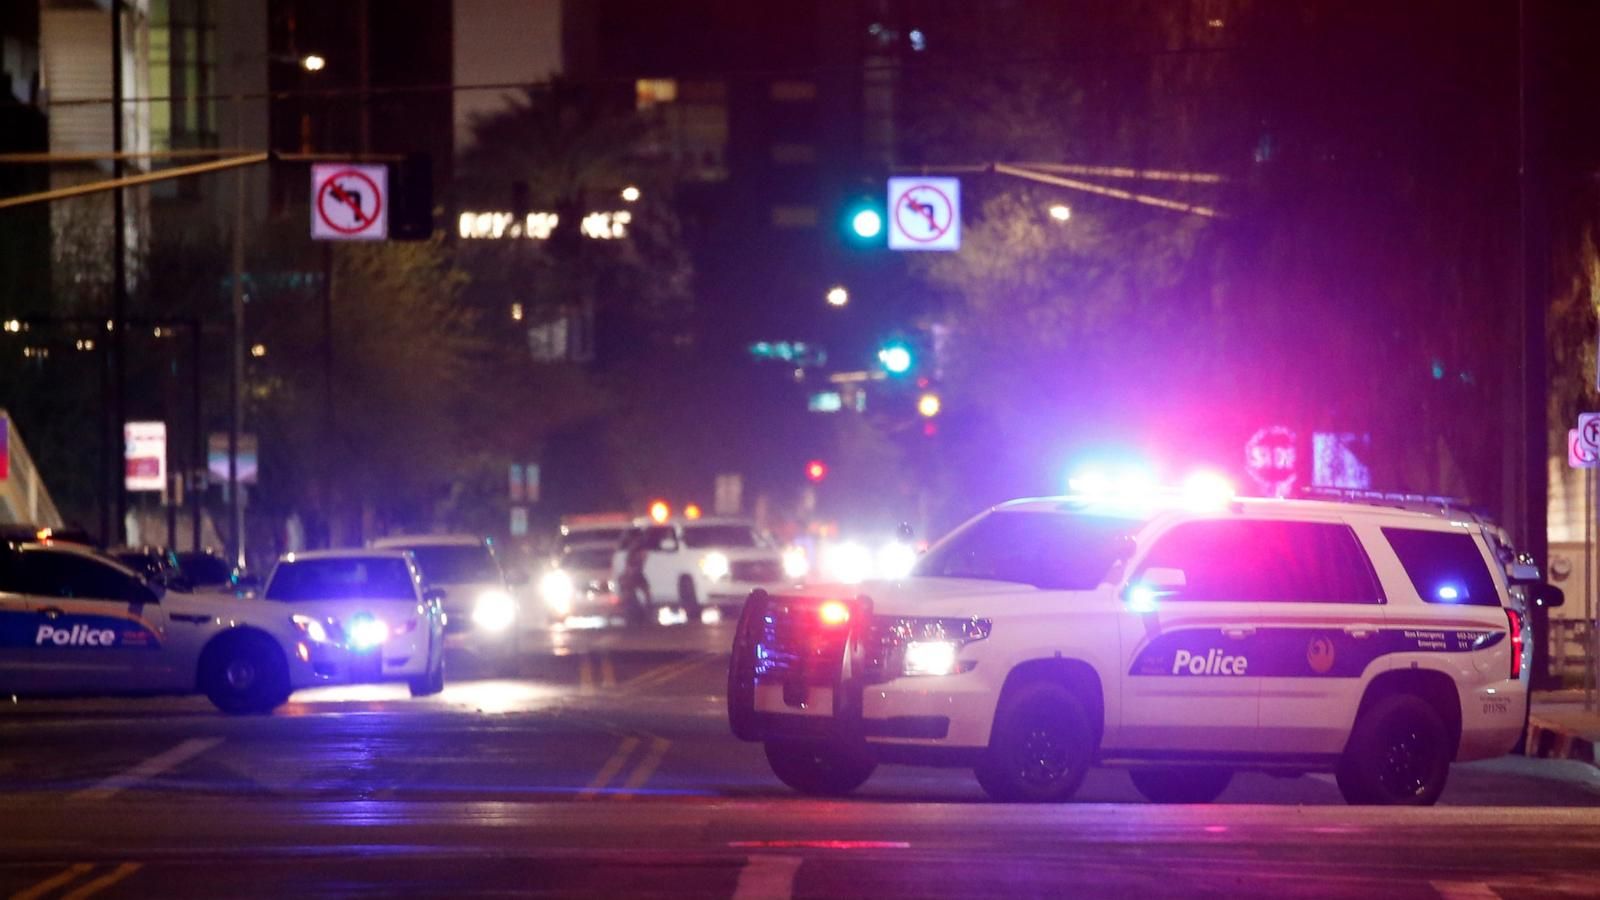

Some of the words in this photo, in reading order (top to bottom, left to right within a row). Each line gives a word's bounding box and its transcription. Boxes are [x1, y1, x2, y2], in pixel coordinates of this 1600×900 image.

[36, 624, 116, 646] Police
[1418, 640, 1447, 649] Emergency
[1172, 648, 1248, 676] Police
